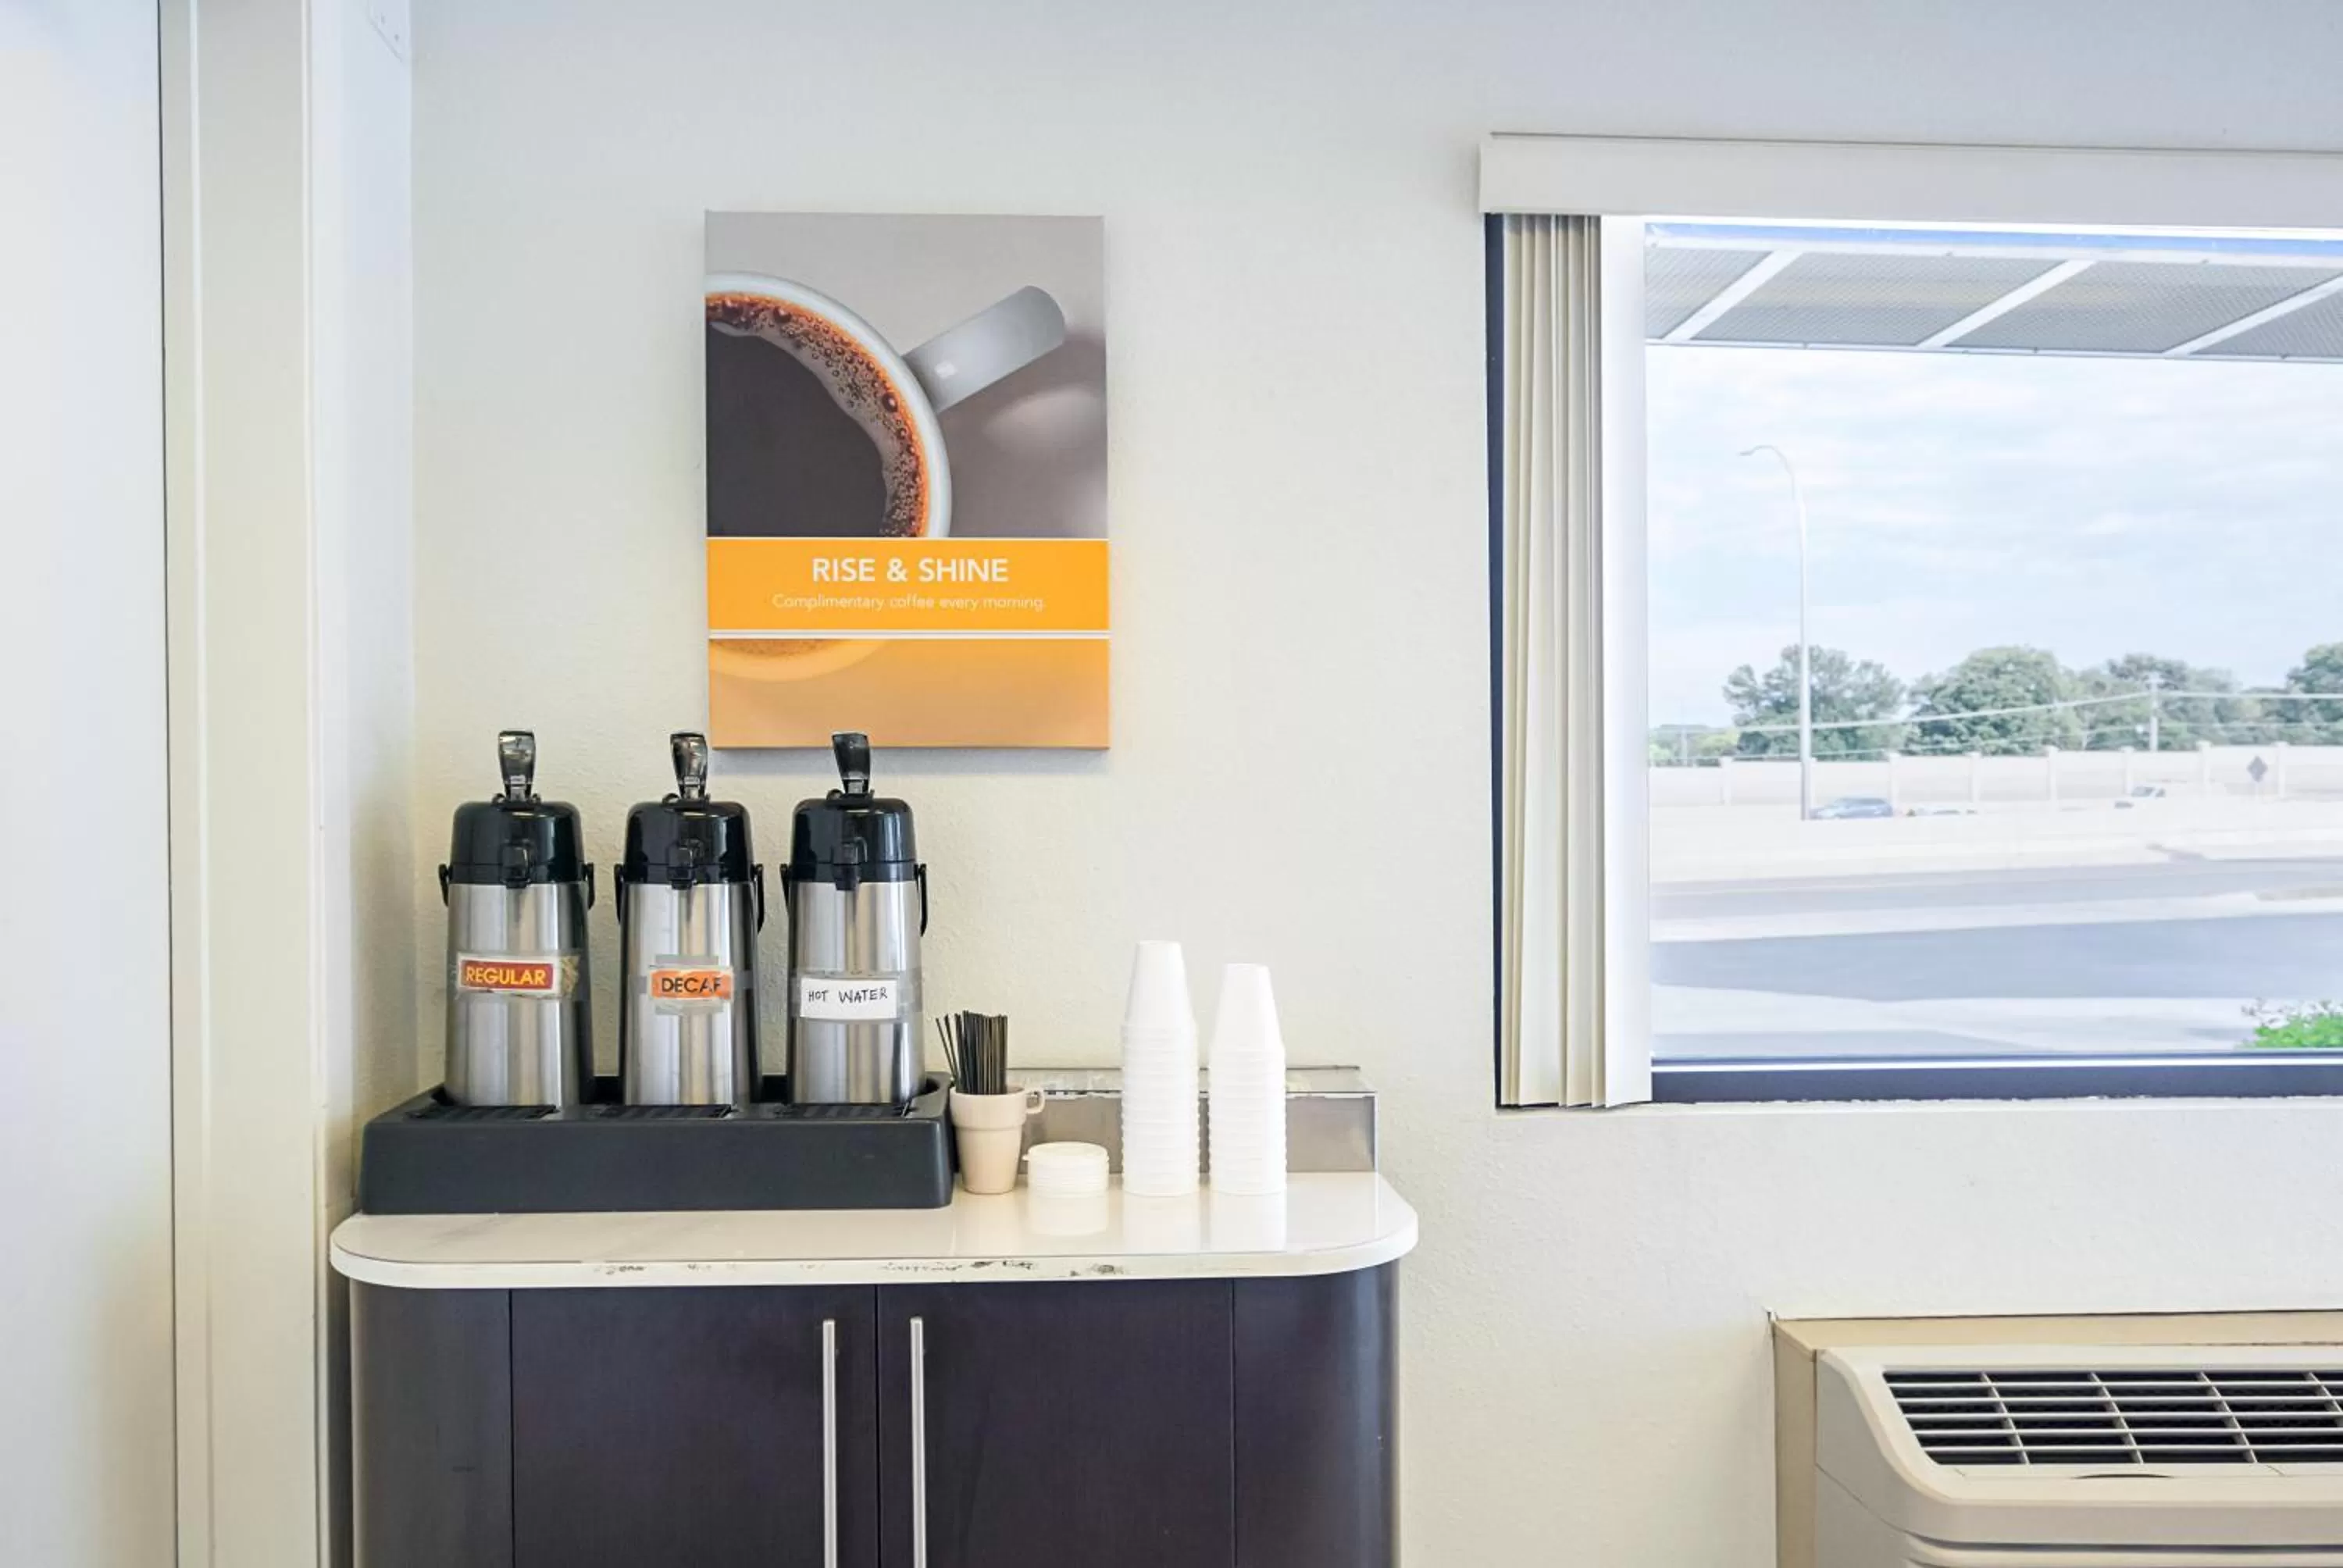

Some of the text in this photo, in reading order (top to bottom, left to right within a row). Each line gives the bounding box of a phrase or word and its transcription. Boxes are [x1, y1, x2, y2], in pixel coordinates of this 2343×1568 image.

[812, 558, 1009, 583] RISE & SHINE
[772, 593, 885, 612] Complimentary
[890, 593, 935, 609] coffee
[940, 597, 978, 612] every
[465, 966, 547, 985] REGULAR
[662, 977, 722, 993] DECAF
[808, 986, 888, 1003] HOT WATER
